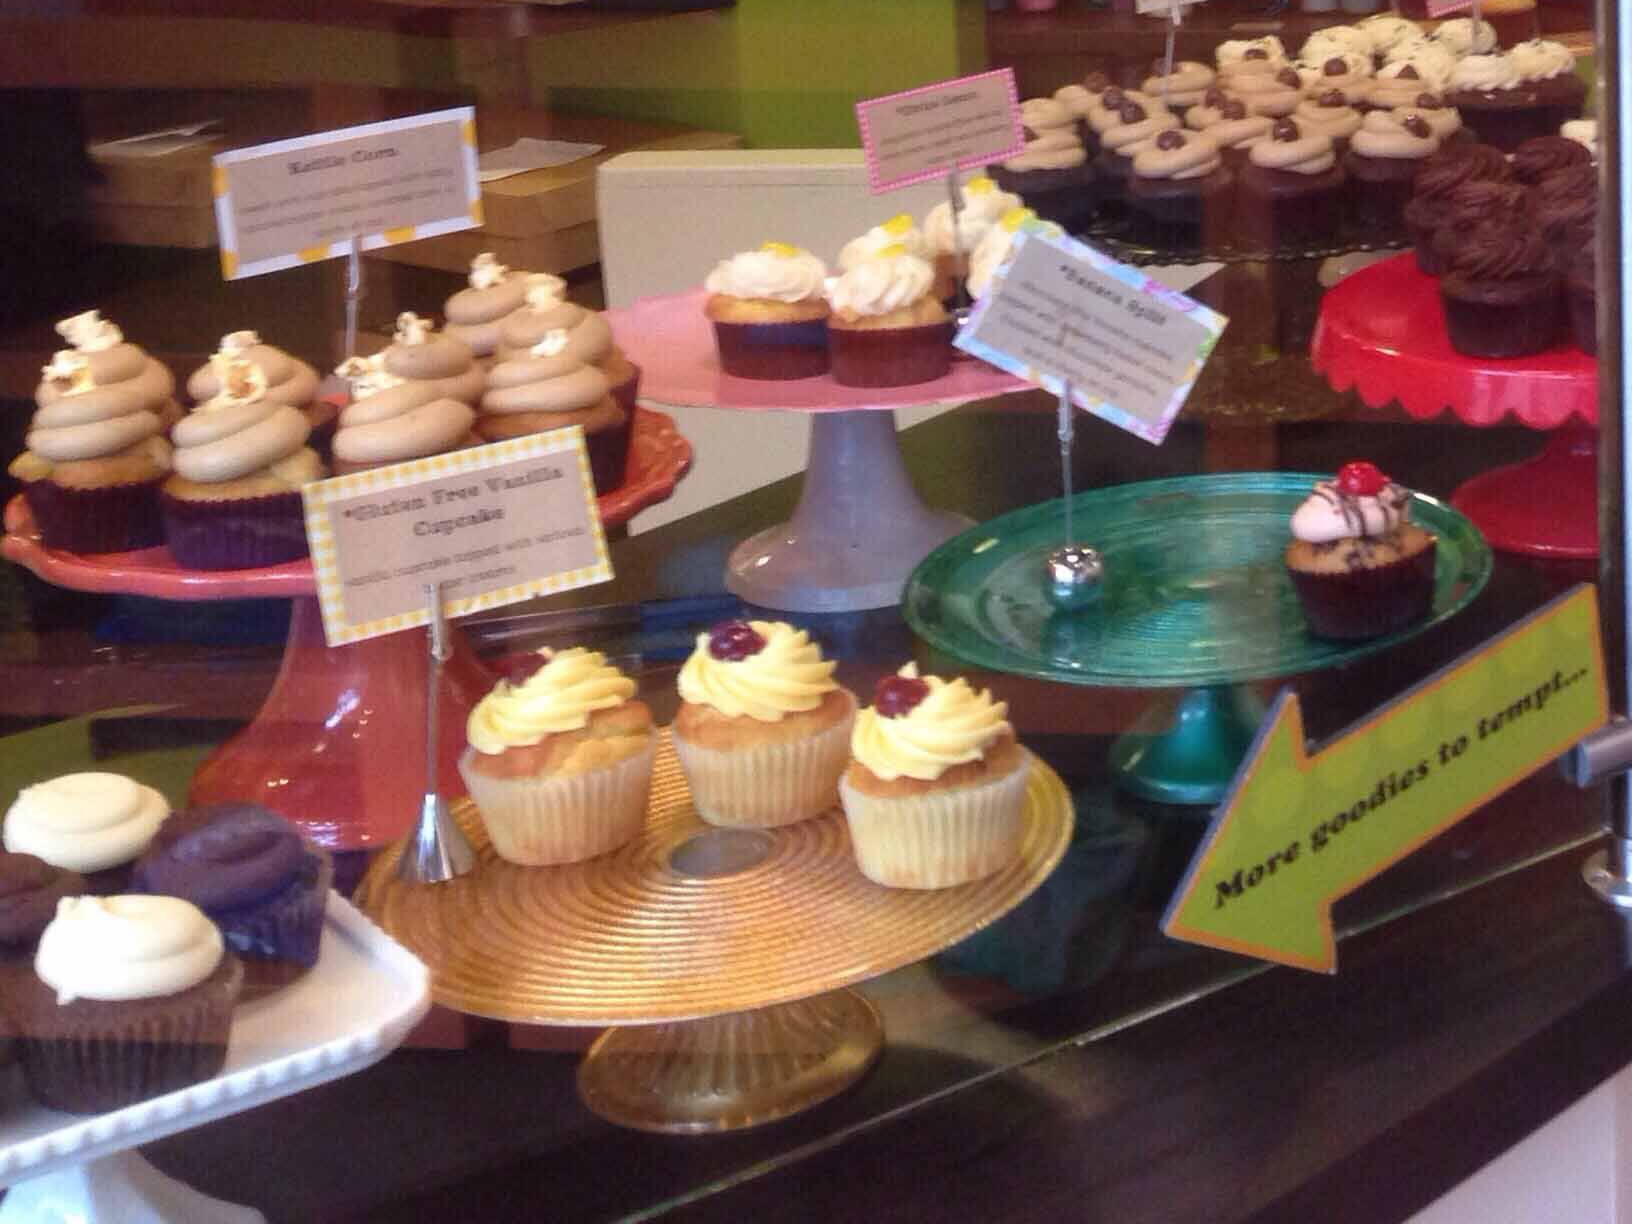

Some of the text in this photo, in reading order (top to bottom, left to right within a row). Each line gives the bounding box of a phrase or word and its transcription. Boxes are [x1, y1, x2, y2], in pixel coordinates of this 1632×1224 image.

[432, 486, 479, 505] Free
[483, 467, 563, 492] Vanilla
[413, 507, 505, 536] Cupcake
[1214, 841, 1301, 909] More
[1310, 760, 1429, 853] goodies
[1439, 735, 1468, 765] to
